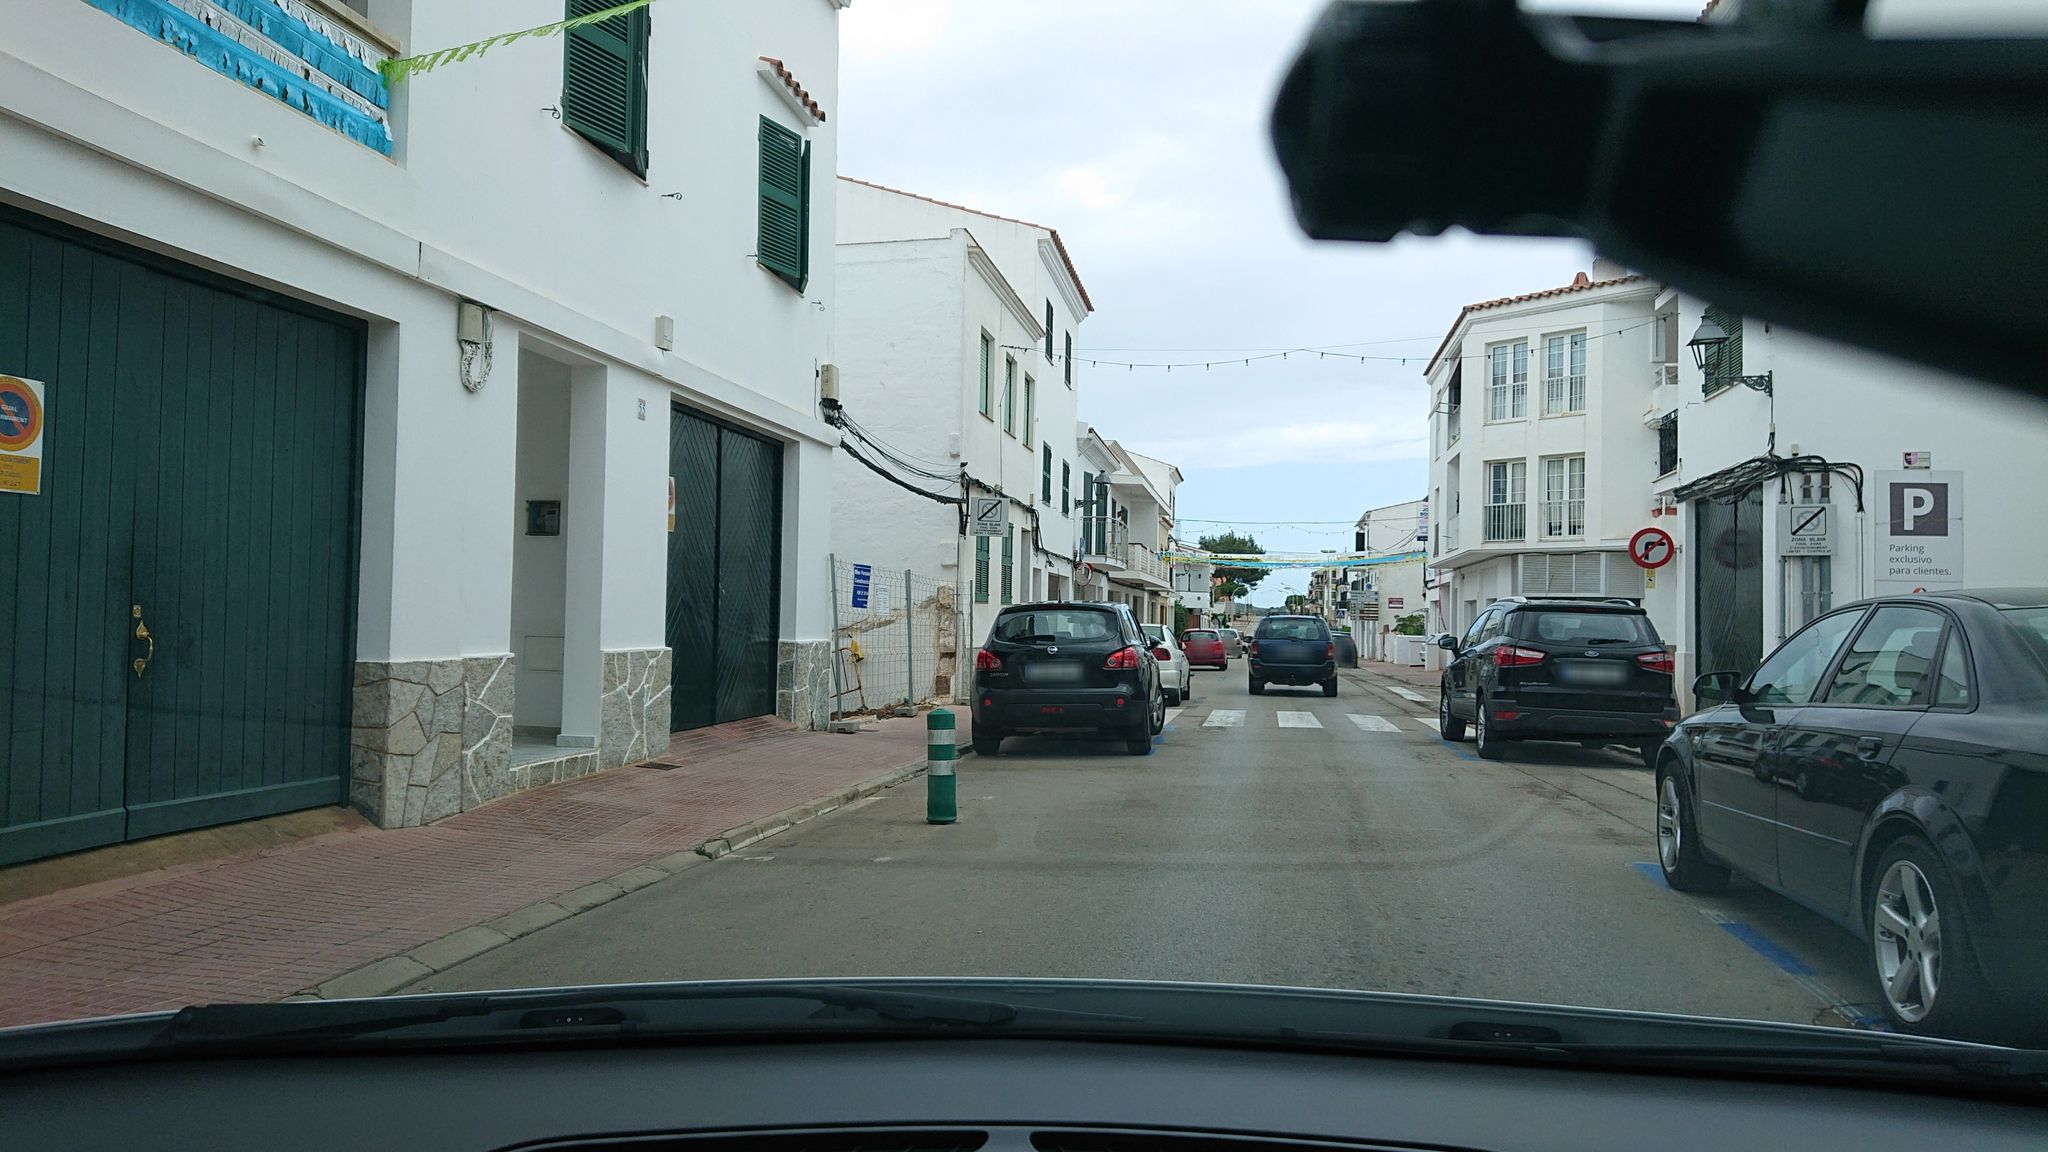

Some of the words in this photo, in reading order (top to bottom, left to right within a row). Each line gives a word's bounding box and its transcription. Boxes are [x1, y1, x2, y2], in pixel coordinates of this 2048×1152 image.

[1903, 488, 1934, 531] P
[1889, 544, 1925, 554] Parking
[1889, 555, 1933, 564] exclusivo
[1889, 567, 1911, 576] para
[1913, 566, 1952, 576] clientes.
